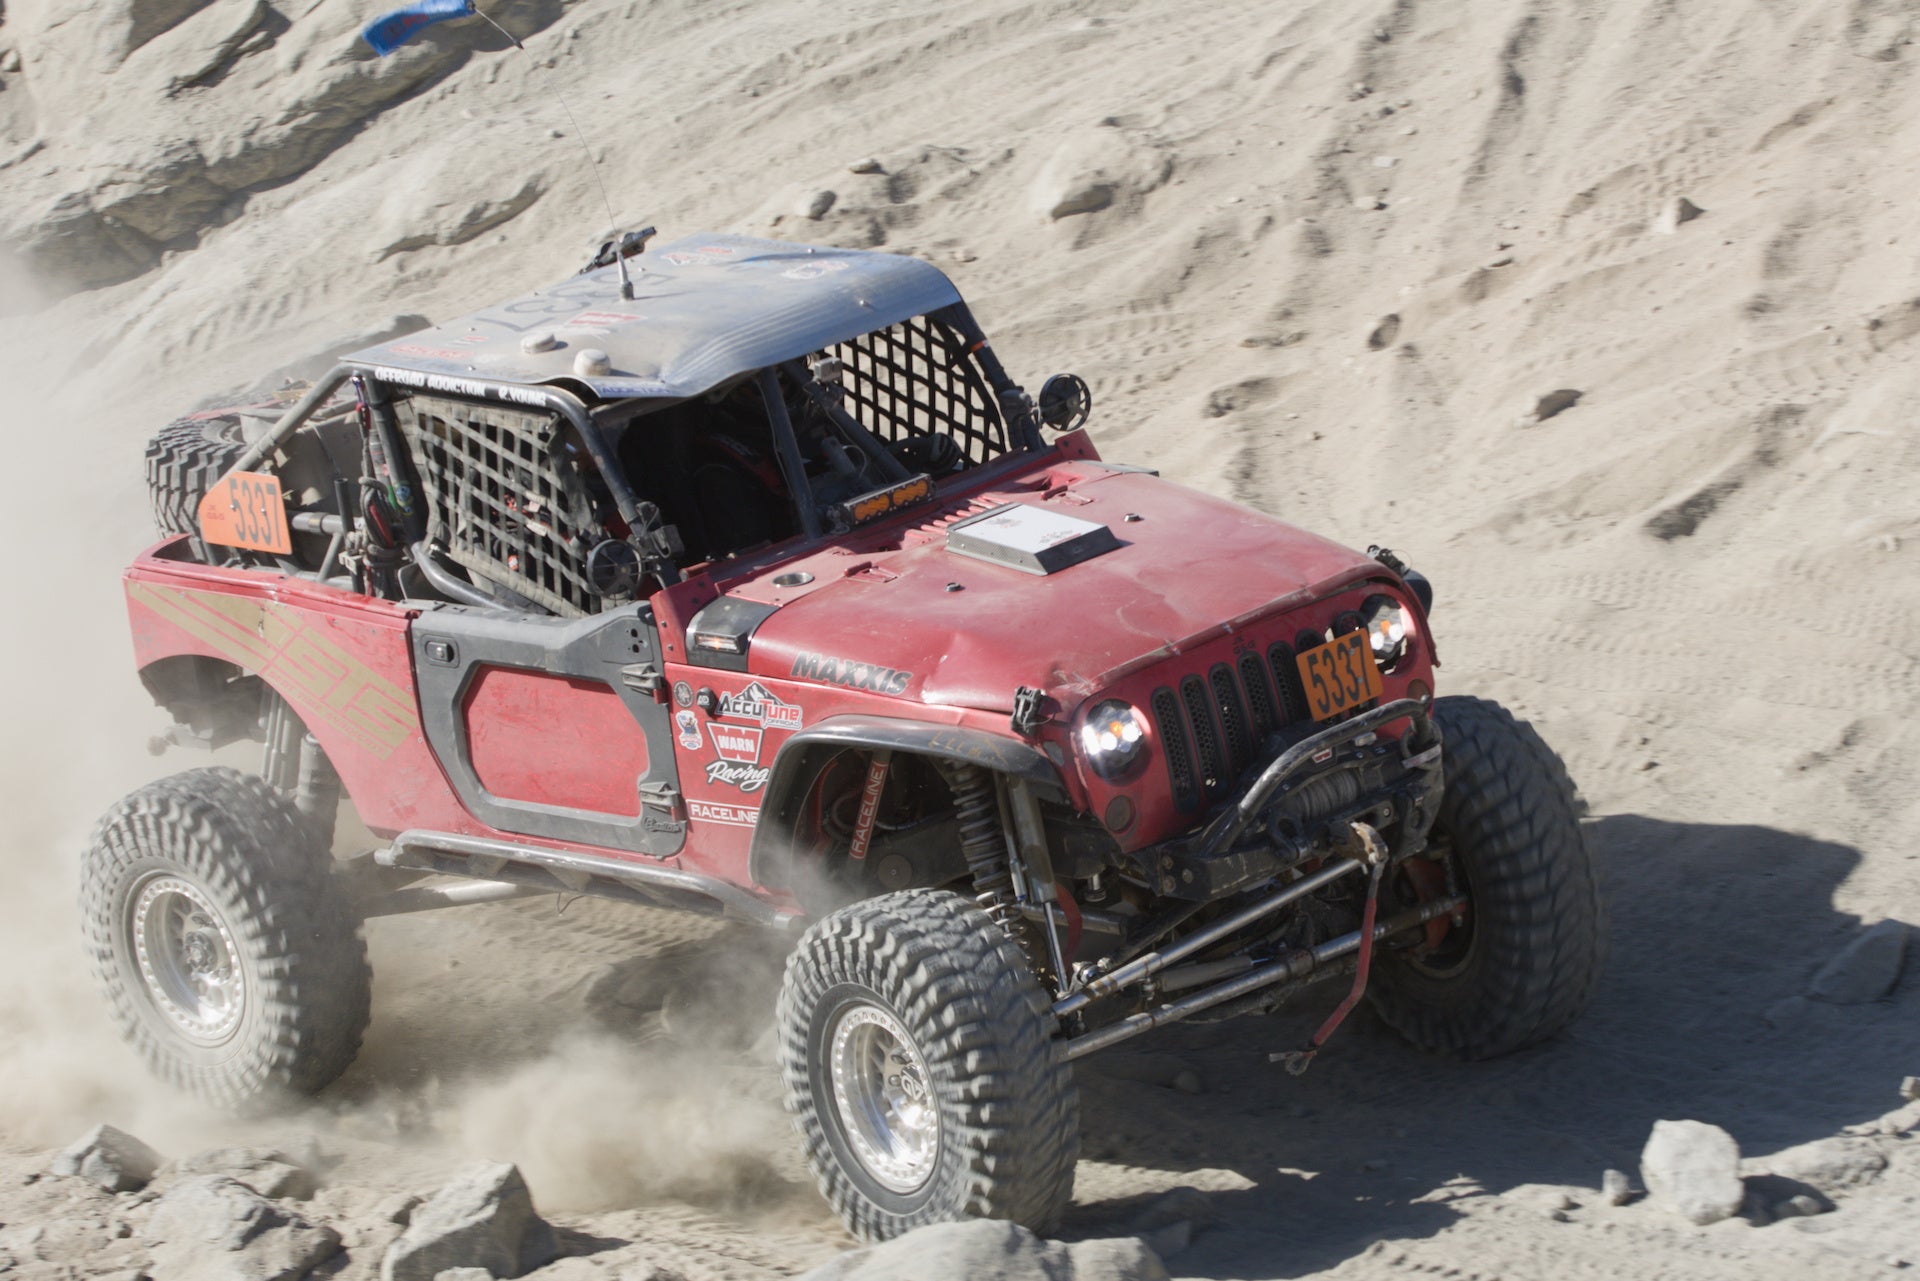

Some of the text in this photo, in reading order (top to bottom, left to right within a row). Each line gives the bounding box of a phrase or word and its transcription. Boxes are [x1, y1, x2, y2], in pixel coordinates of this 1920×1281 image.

[374, 366, 425, 388] OFFROAD
[427, 375, 486, 397] ADDICTION
[228, 478, 282, 548] 5337
[791, 652, 914, 695] MAXXIS
[1306, 634, 1372, 714] 5337
[766, 718, 800, 727] OFFROAD
[717, 735, 755, 753] WARN
[706, 760, 770, 792] Racing
[690, 803, 760, 823] RACELINE
[851, 766, 885, 854] RACELINE
